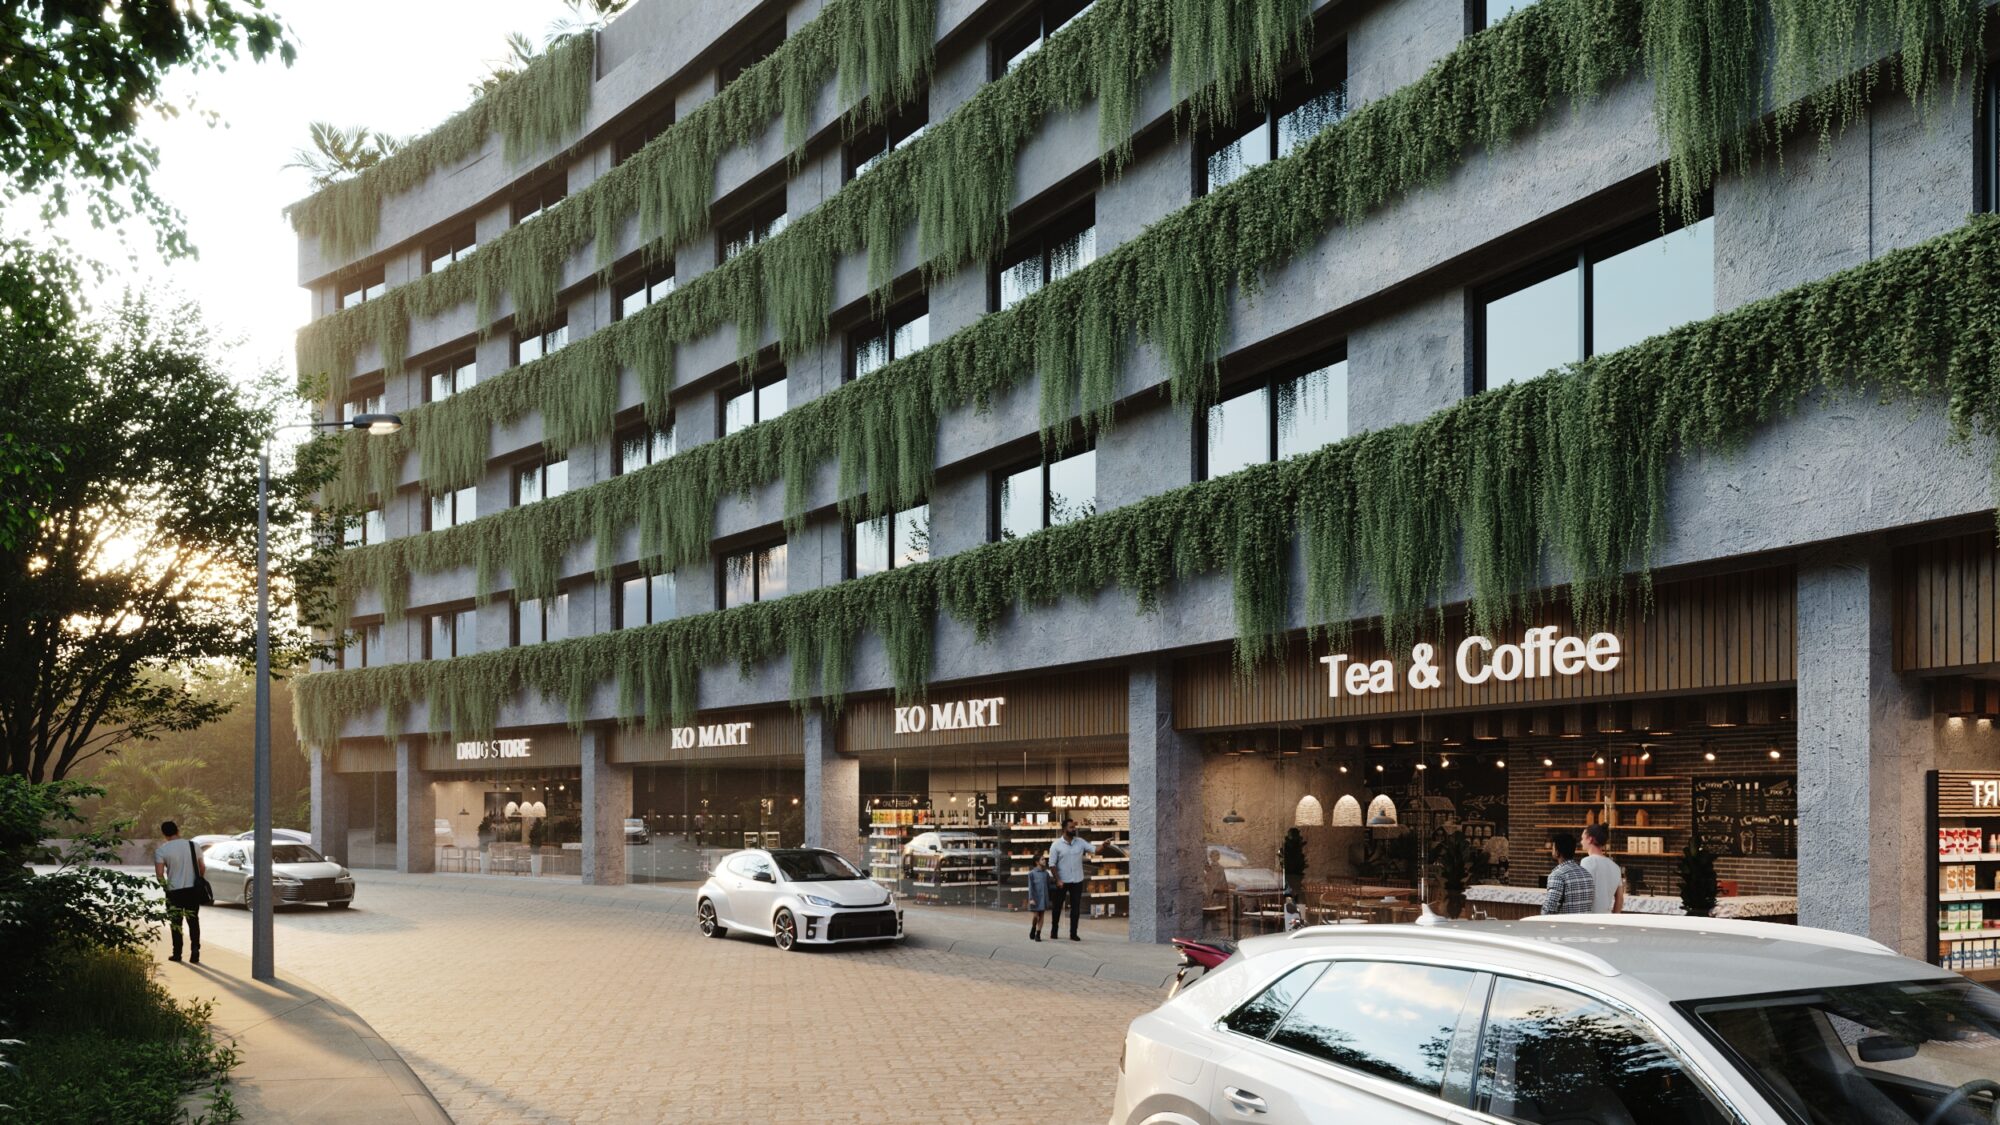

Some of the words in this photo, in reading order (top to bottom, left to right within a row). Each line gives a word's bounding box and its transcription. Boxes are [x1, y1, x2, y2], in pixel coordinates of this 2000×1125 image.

[1320, 653, 1394, 698] Tea
[1408, 642, 1441, 690] &
[1456, 625, 1621, 685] Coffee
[894, 705, 926, 734] KO
[931, 697, 1005, 731] MART
[671, 727, 696, 749] KO
[698, 722, 752, 748] MART
[456, 741, 489, 760] DRUG
[490, 738, 531, 759] STORE
[977, 799, 986, 817] 5
[1052, 795, 1077, 807] MEAT
[1079, 795, 1100, 807] AND
